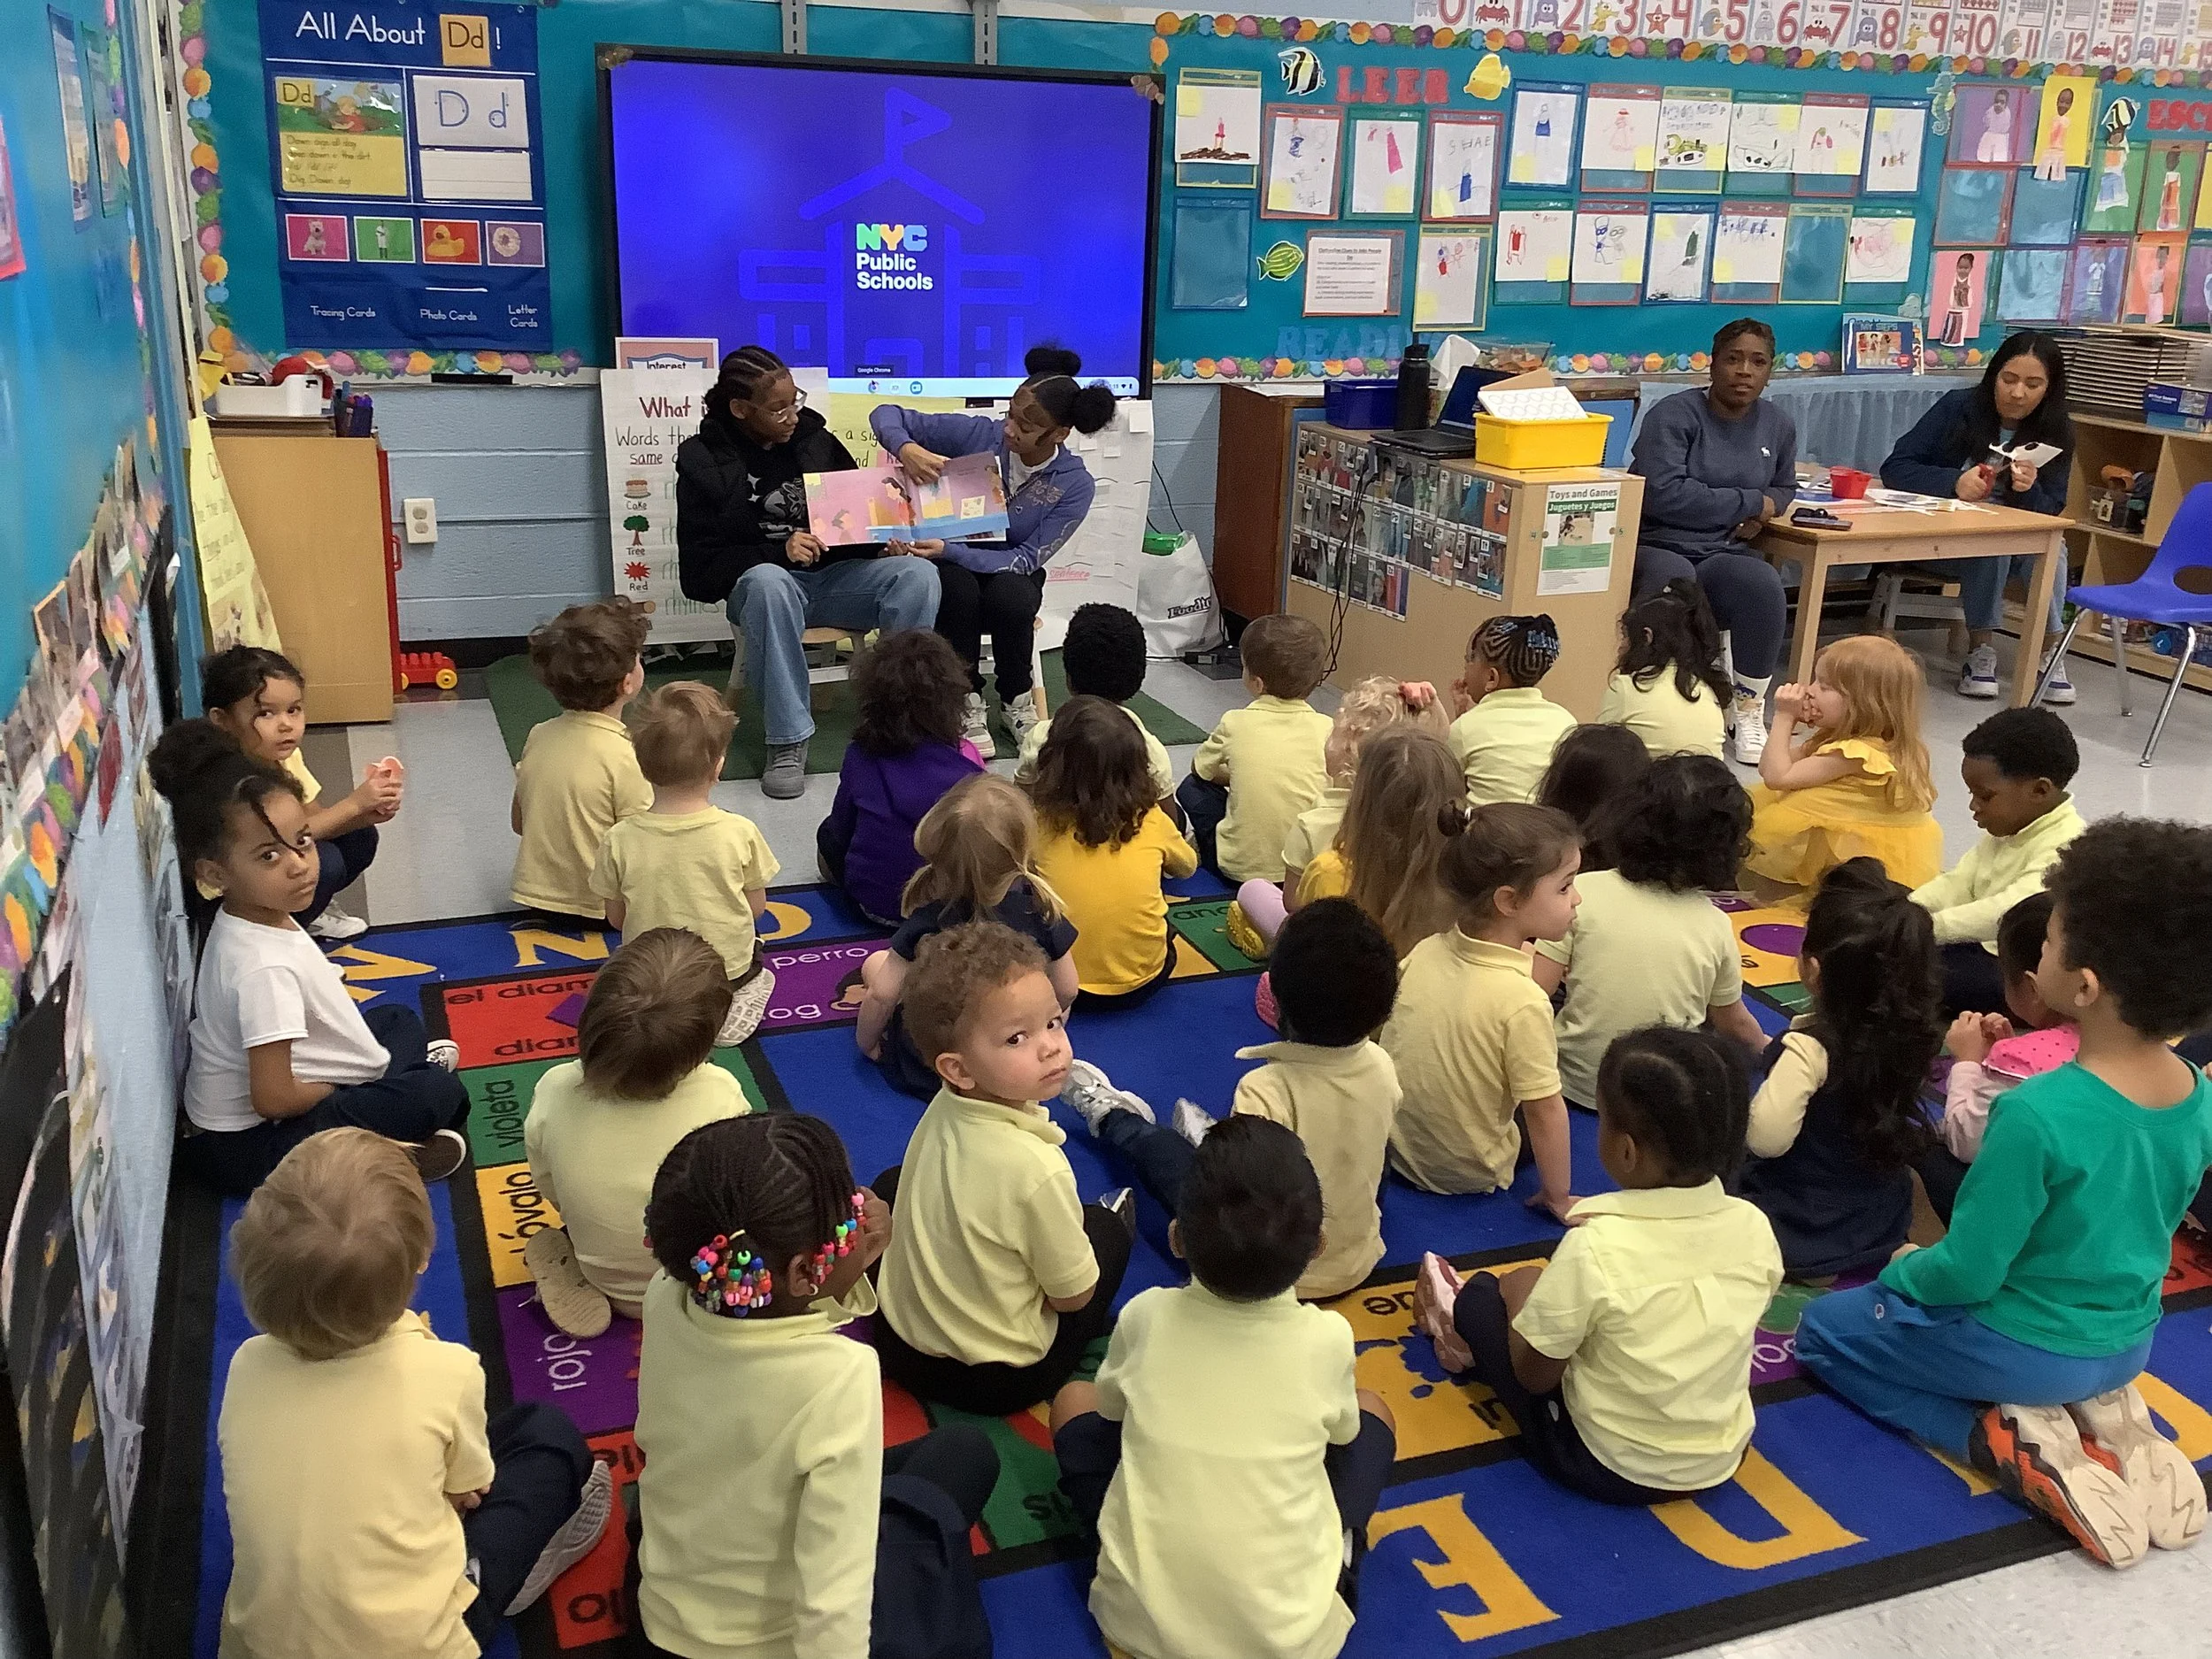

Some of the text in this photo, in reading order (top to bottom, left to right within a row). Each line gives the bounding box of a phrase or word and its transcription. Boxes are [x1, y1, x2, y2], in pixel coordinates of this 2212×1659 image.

[296, 11, 336, 40] All
[345, 14, 426, 45] About
[447, 21, 485, 49] Dd
[1562, 0, 1584, 31] 2
[1616, 0, 1638, 35] 3
[1670, 0, 1691, 37] 4
[1724, 0, 1747, 41] 5
[1777, 3, 1798, 44] 6
[1828, 4, 1851, 46] 7
[1878, 8, 1901, 50] 8
[1929, 12, 1950, 53] 9
[1965, 12, 1997, 55] 10
[2024, 28, 2041, 58] 11
[2068, 32, 2088, 62] 12
[2112, 35, 2132, 65] 13
[2154, 38, 2175, 65] 14
[282, 82, 311, 104] Dd
[1336, 66, 1448, 104] LEER
[438, 89, 469, 127] D
[488, 92, 509, 128] d
[856, 223, 927, 251] NYC
[856, 252, 917, 272] Public
[856, 272, 933, 290] Schools
[311, 305, 376, 320] Tracing Cards
[420, 310, 478, 321] Photo Cards
[509, 304, 537, 315] Letter
[510, 318, 538, 328] Cards
[1274, 325, 1438, 361] READI
[639, 396, 692, 419] What
[615, 426, 660, 446] Words
[845, 430, 854, 440] a
[629, 453, 664, 465] same
[855, 449, 870, 468] nd
[1549, 488, 1618, 501] Toys and Games
[626, 501, 648, 511] Cake
[1548, 503, 1583, 512] Juguetes
[1590, 501, 1616, 511] Juegos
[626, 547, 646, 557] Tree
[1048, 567, 1091, 579] sentence
[629, 580, 649, 591] Red
[771, 947, 869, 970] perro
[447, 977, 595, 1005] el diam
[764, 1003, 823, 1021] og
[484, 1079, 526, 1150] violeta
[535, 1333, 593, 1392] rojo
